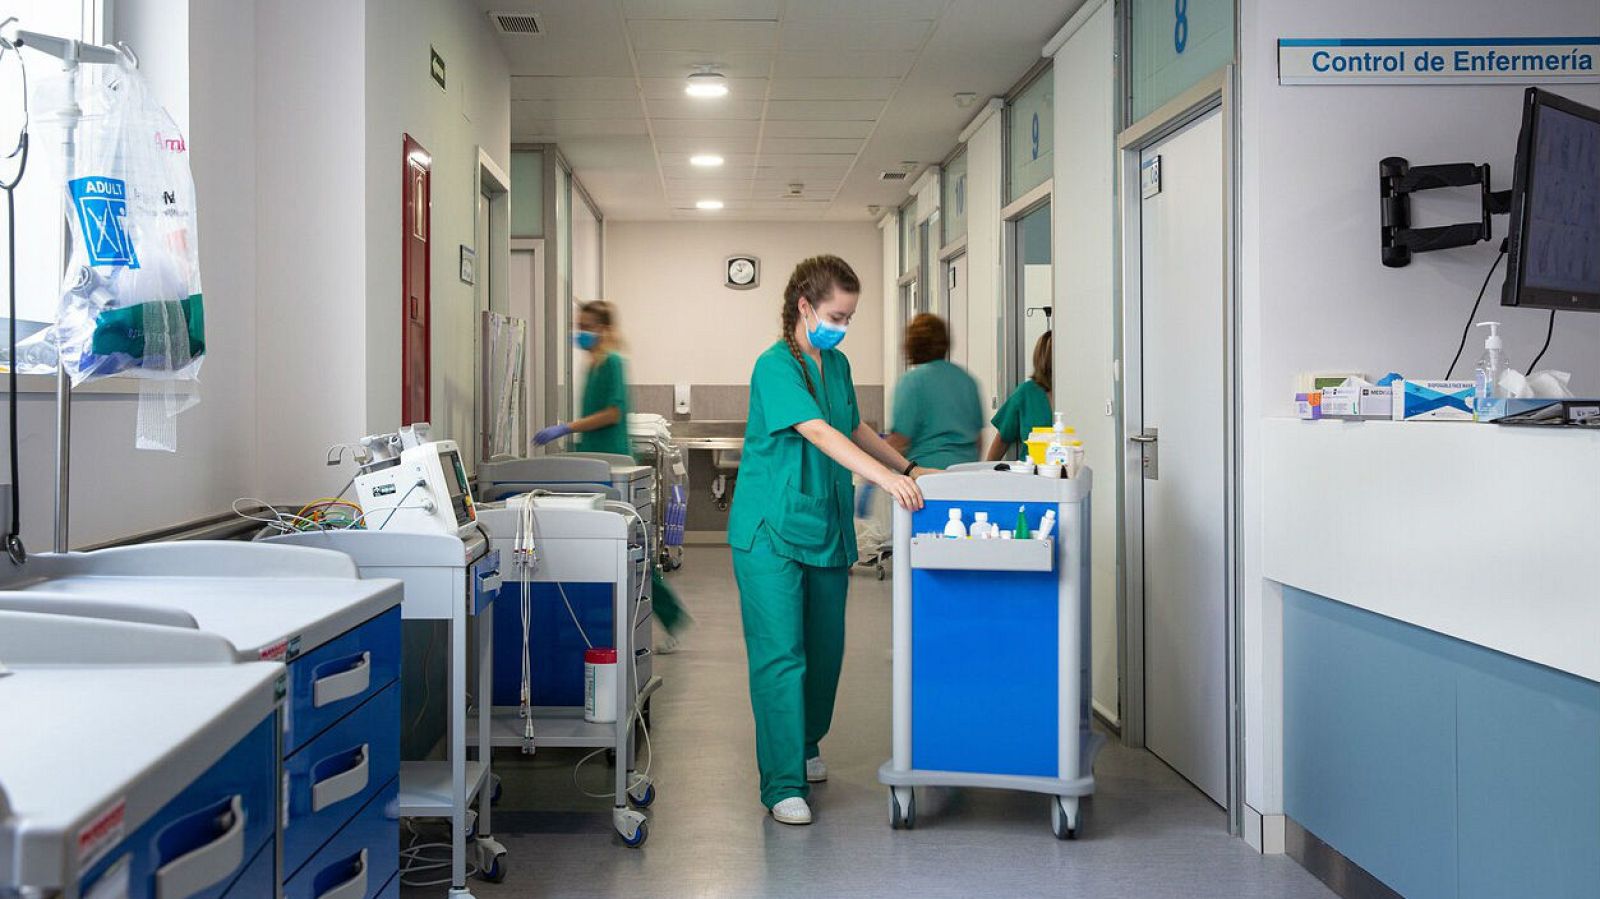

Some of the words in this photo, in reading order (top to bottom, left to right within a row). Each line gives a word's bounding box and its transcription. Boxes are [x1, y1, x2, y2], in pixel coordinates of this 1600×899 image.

[1175, 0, 1188, 53] 8
[1312, 51, 1405, 72] Control
[1414, 51, 1445, 72] de
[1454, 48, 1593, 72] Enfermería
[1031, 112, 1040, 161] 9
[85, 180, 122, 195] ADULT
